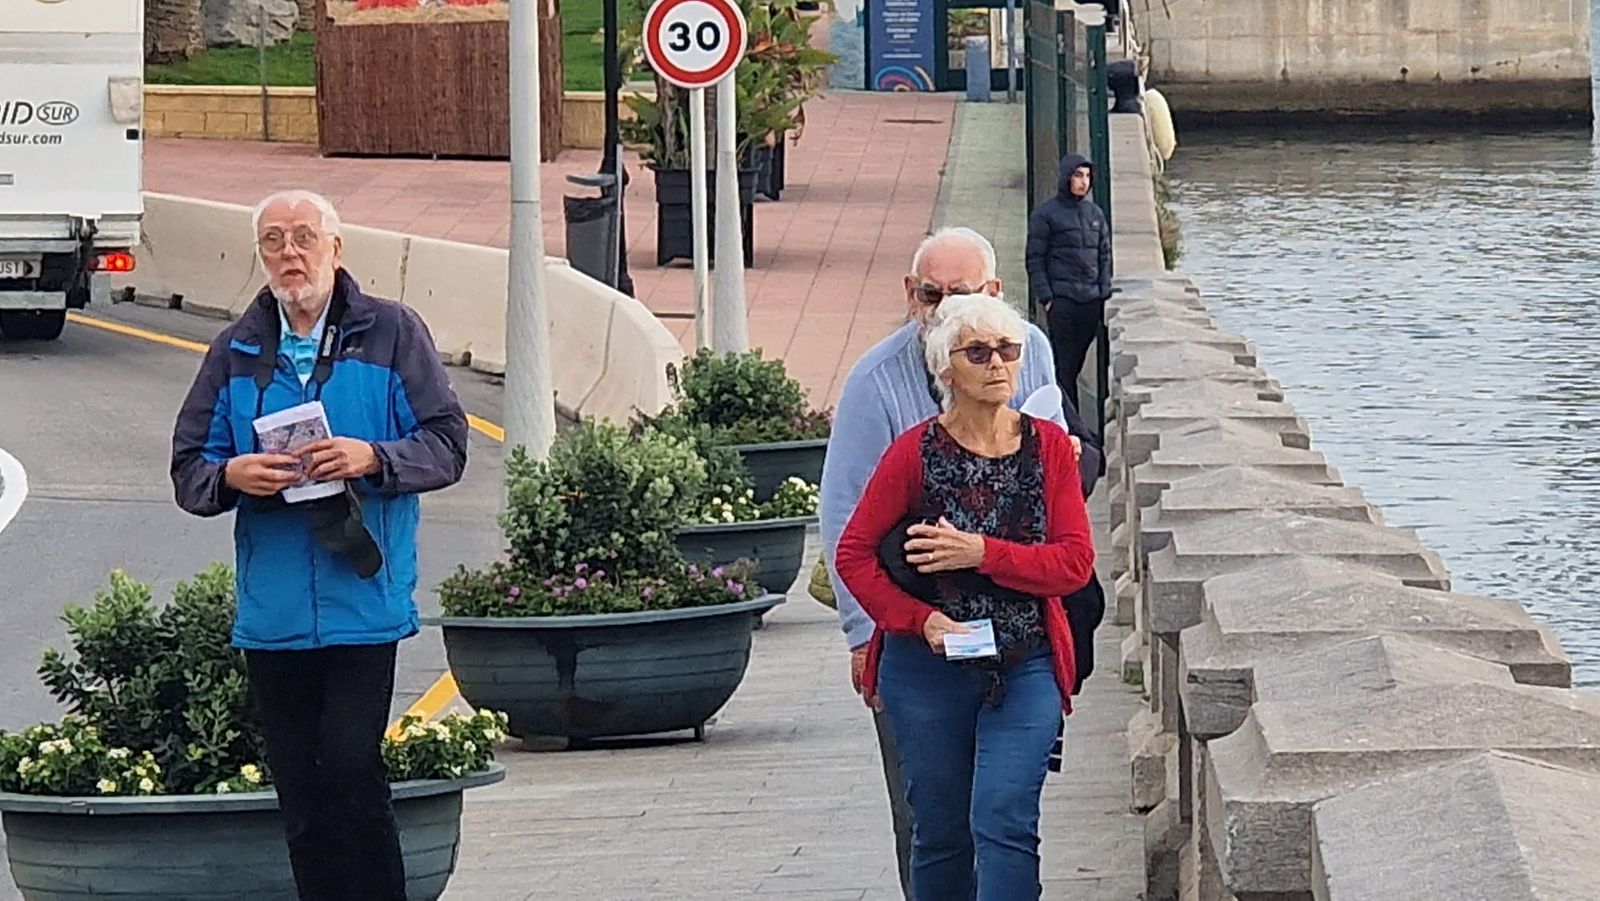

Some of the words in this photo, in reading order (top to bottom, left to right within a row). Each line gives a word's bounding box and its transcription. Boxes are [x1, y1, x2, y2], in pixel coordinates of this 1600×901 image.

[668, 21, 720, 52] 30
[0, 101, 33, 125] ID
[42, 106, 73, 121] SUR
